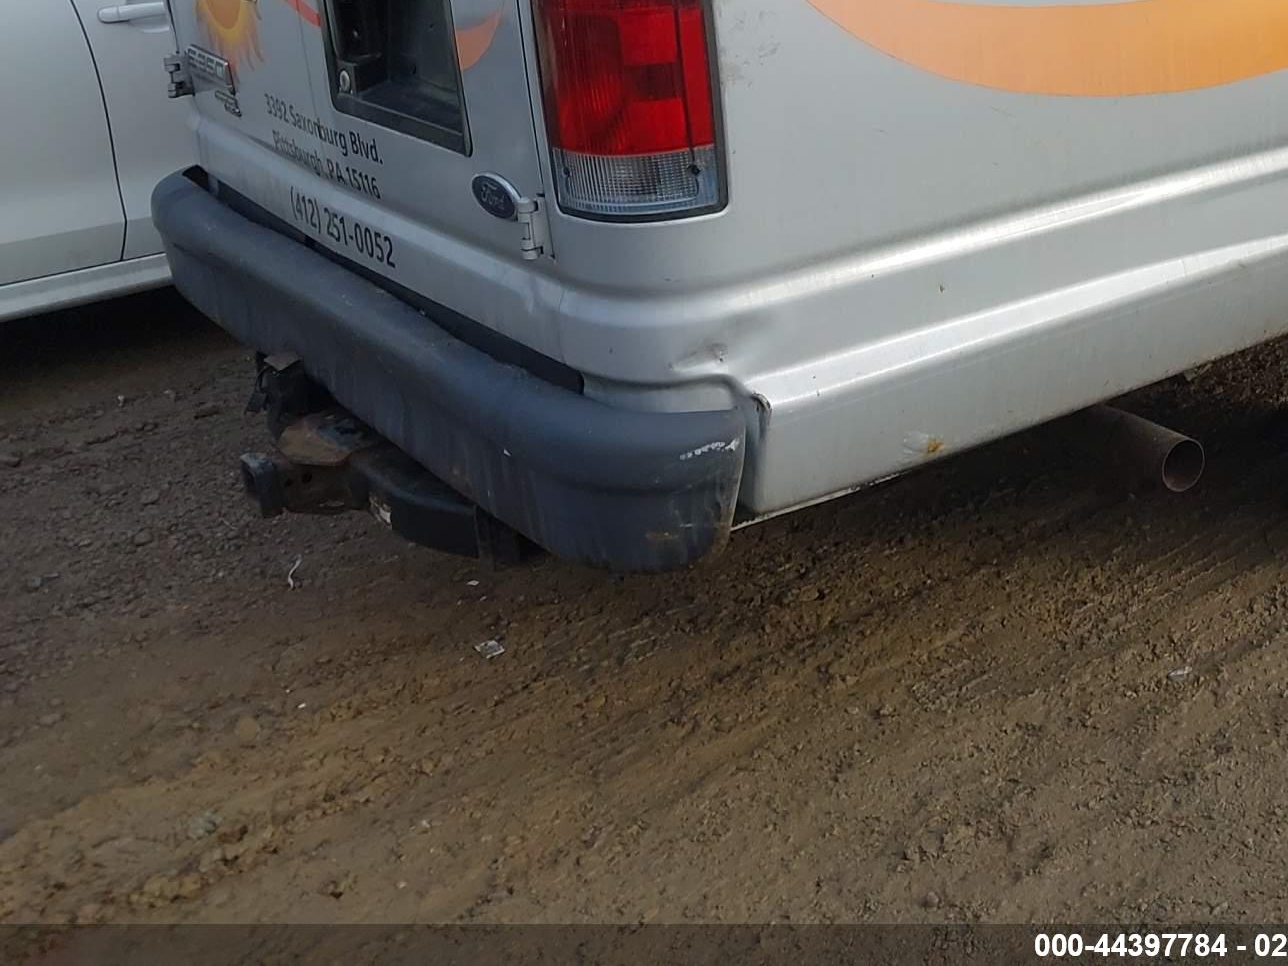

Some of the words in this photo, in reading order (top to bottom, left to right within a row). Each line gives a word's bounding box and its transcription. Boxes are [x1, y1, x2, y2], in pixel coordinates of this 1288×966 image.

[264, 93, 290, 124] 3392
[289, 104, 349, 157] Saxonburg
[350, 131, 384, 165] Blvd.
[327, 158, 346, 185] PA
[346, 166, 381, 199] 15116
[290, 186, 322, 235] (412)
[323, 207, 396, 268] 251-0052
